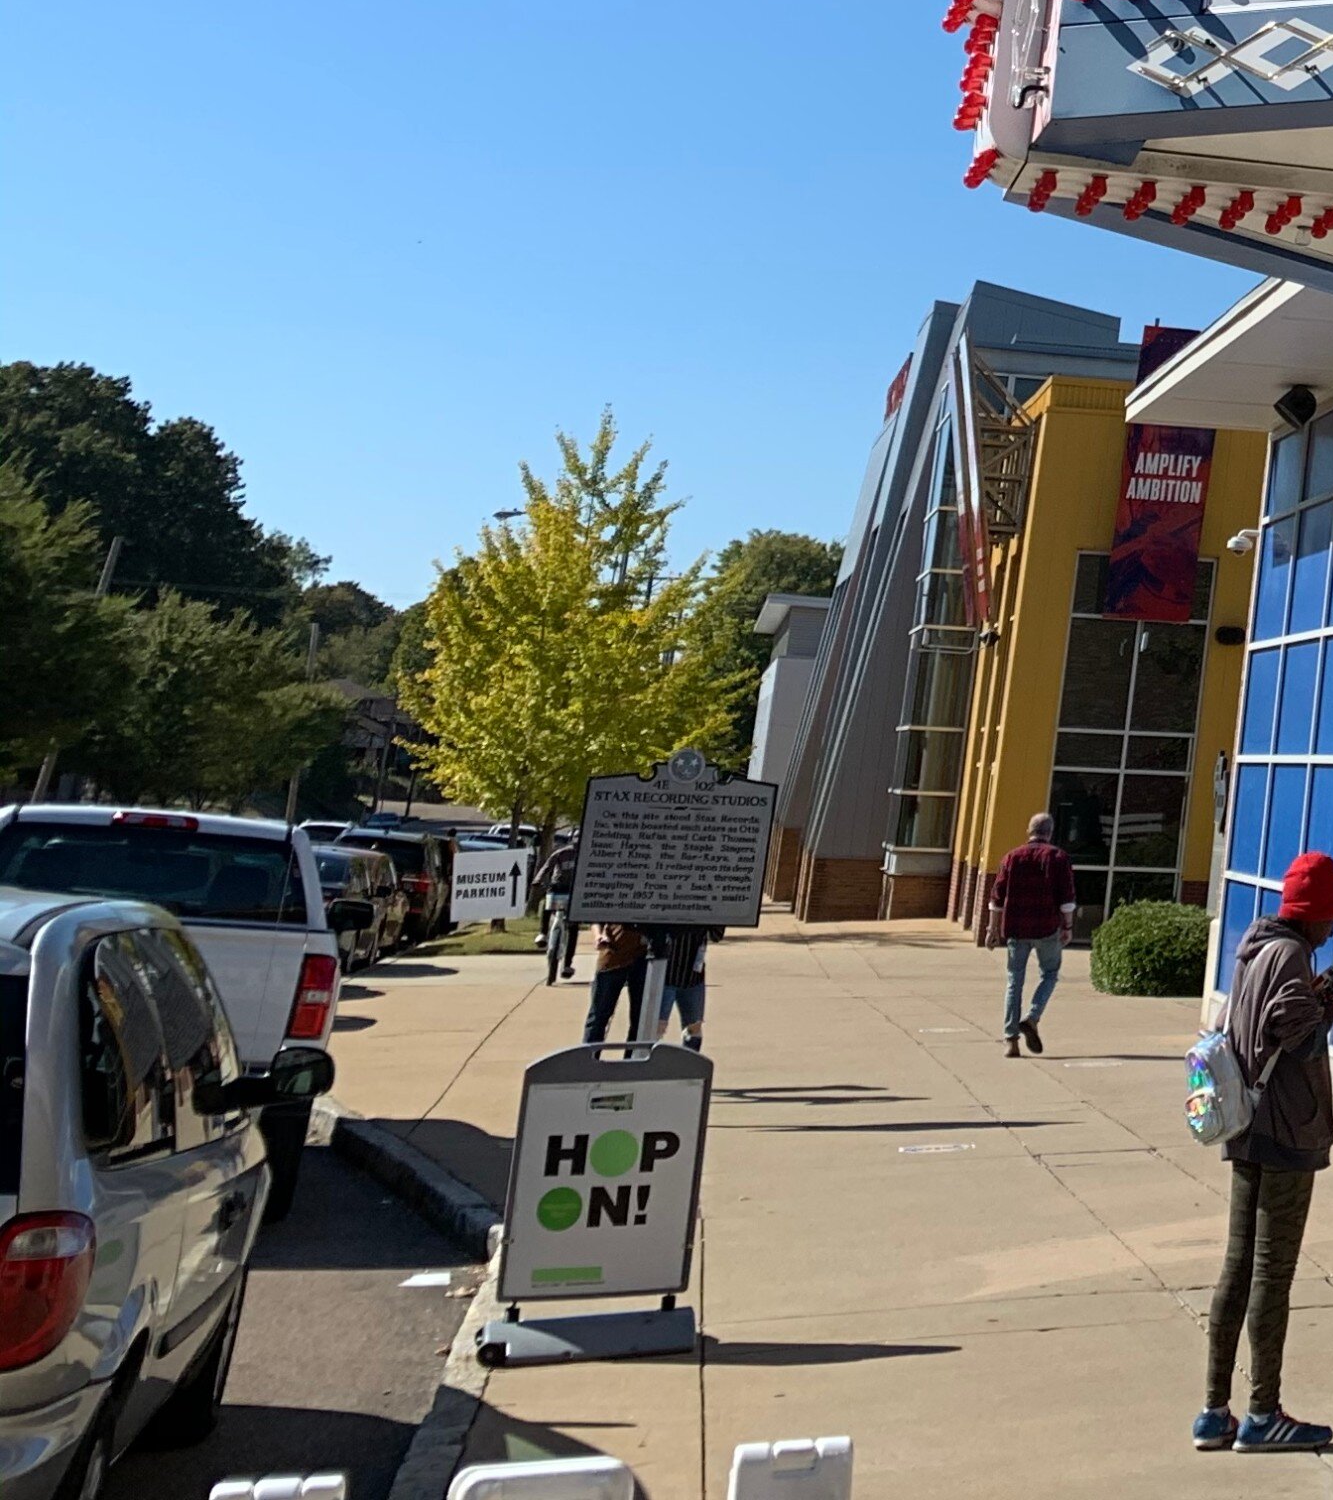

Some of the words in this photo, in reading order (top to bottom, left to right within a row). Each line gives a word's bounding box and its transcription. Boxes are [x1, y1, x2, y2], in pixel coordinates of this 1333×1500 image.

[1134, 451, 1202, 478] AMPLIFY
[1126, 477, 1202, 504] AMBITION
[594, 791, 630, 801] STAX
[634, 793, 709, 805] RECORDING
[711, 795, 768, 807] STUDIOS
[602, 810, 617, 819] On
[622, 810, 639, 820] this
[664, 812, 690, 821] stood
[695, 812, 715, 822] Stax
[661, 842, 676, 850] the
[589, 849, 622, 858] Albert
[660, 851, 675, 860] the
[737, 854, 756, 863] and
[456, 872, 506, 884] MUSEUM
[644, 881, 667, 890] from
[455, 887, 506, 899] PARKING
[544, 1129, 680, 1178] HOP
[536, 1184, 651, 1232] ON!
